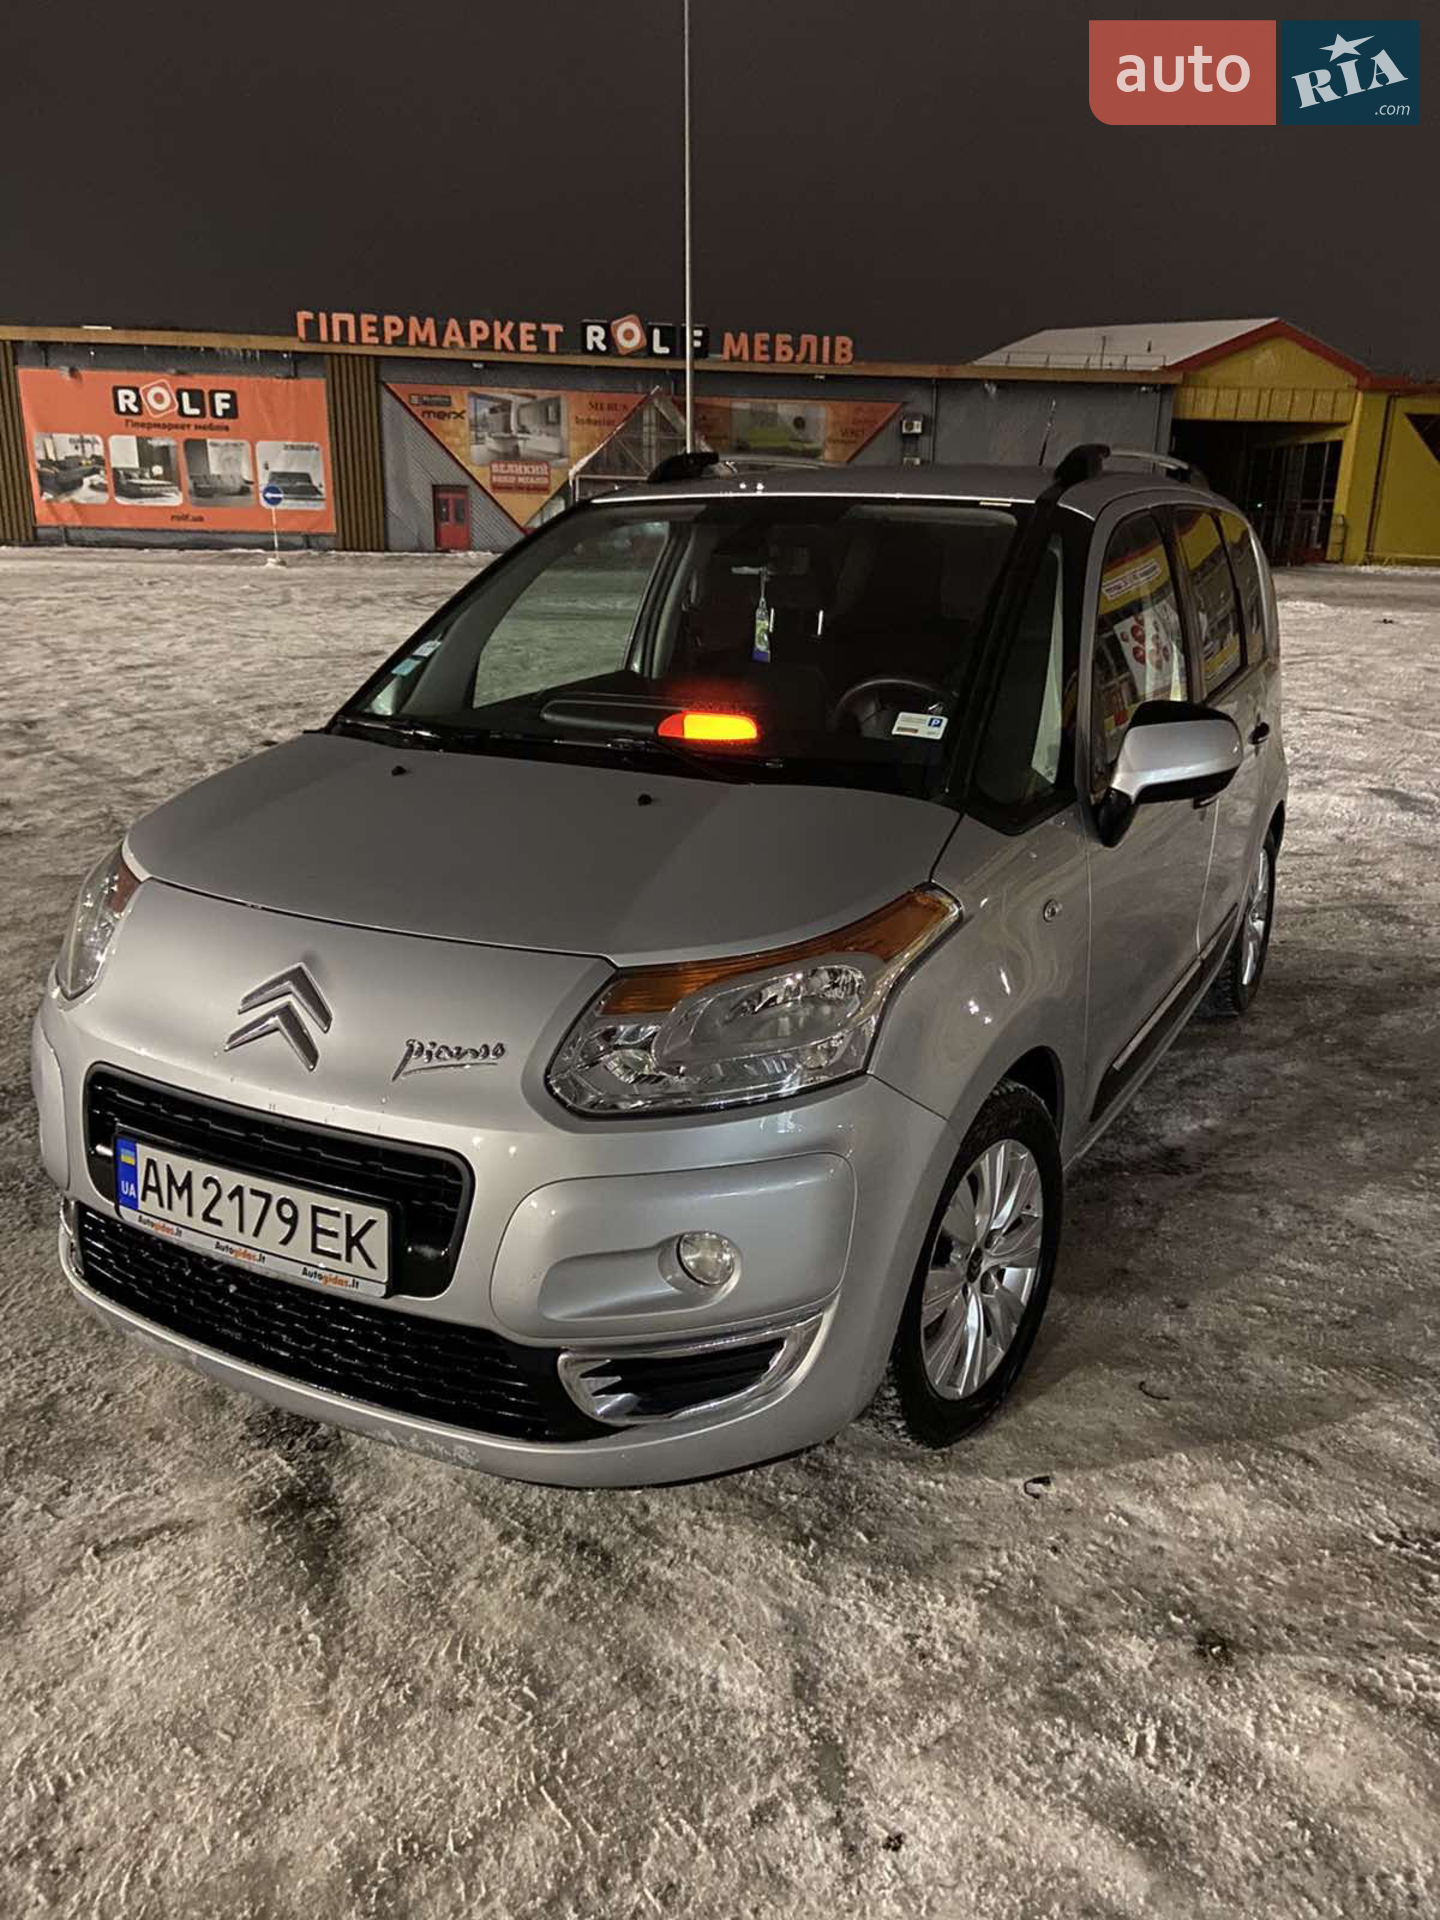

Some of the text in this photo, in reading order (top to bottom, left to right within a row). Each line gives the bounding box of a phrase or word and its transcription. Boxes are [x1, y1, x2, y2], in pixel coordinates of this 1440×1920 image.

[296, 310, 565, 354] ГІПЕРМАРКЕТ
[722, 332, 854, 365] МЕБЛІВ
[116, 384, 233, 416] ROLF
[120, 1180, 138, 1199] UA
[139, 1157, 379, 1270] AM 2179 EK
[301, 1266, 360, 1289] Autogidas.lt
